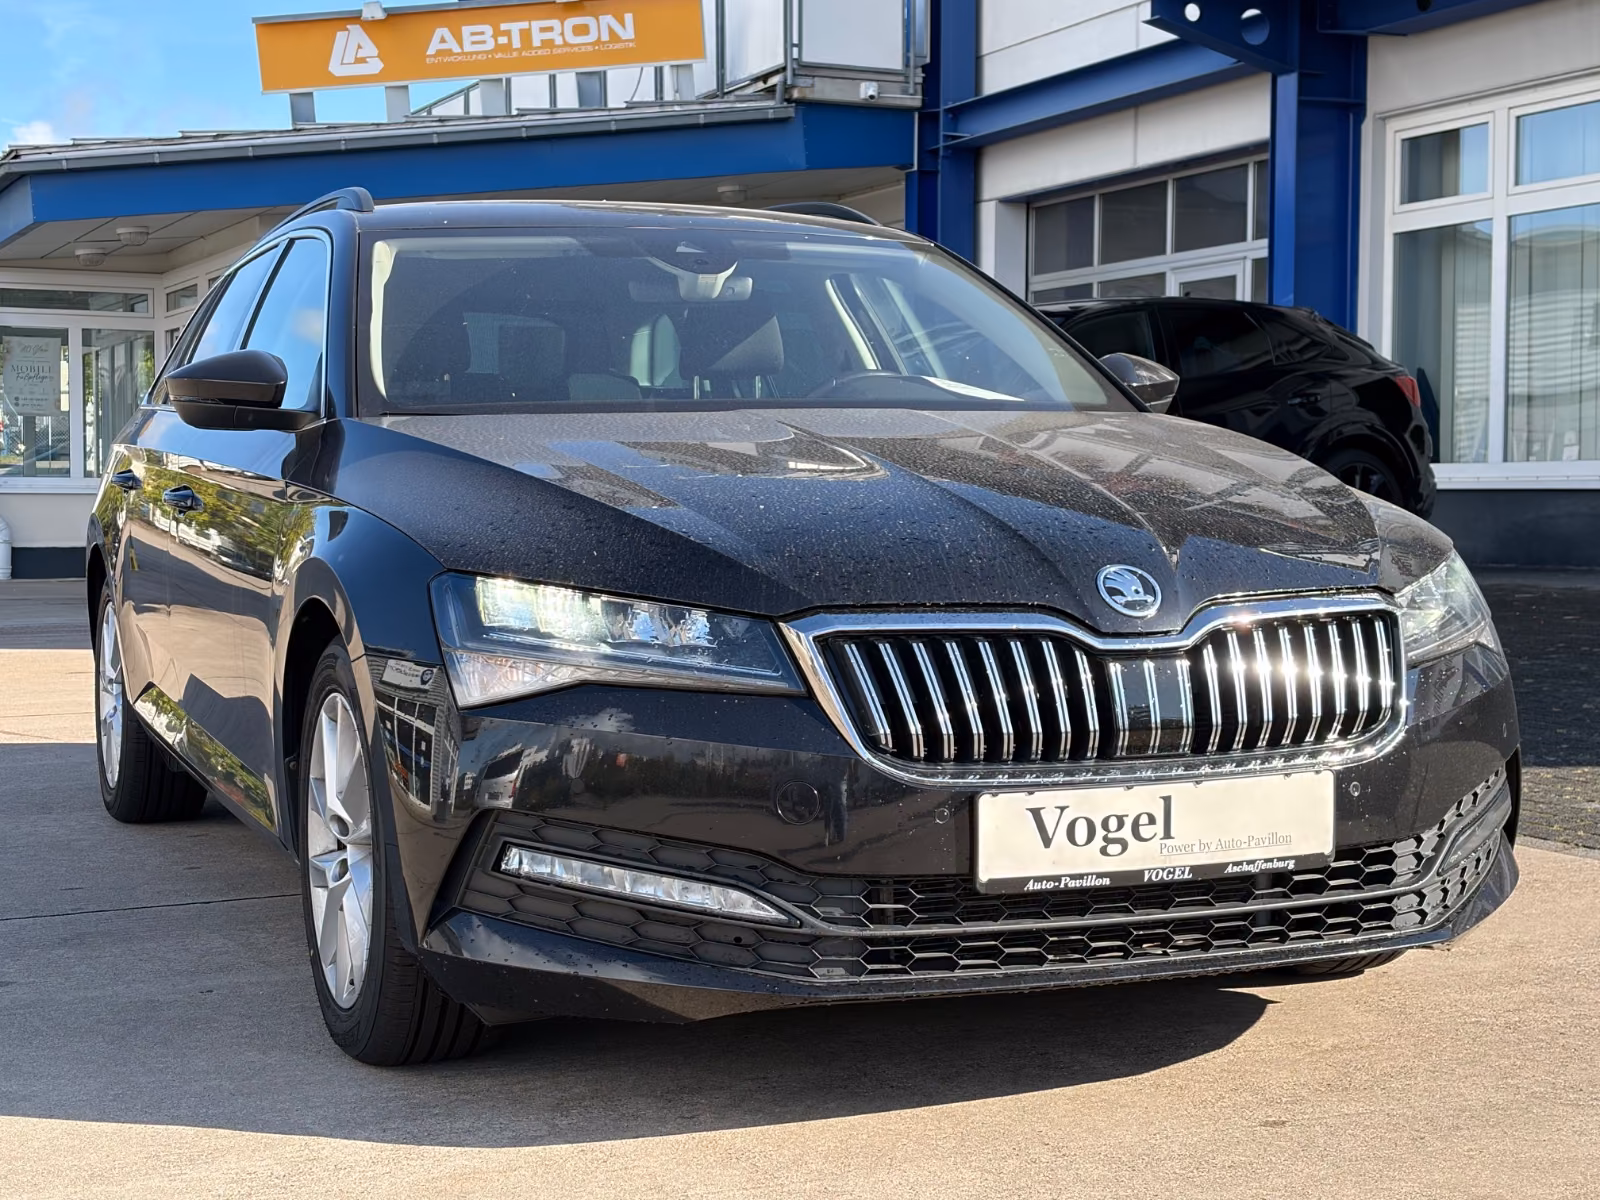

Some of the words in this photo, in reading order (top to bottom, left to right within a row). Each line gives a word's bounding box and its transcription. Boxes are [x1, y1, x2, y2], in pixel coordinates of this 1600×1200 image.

[426, 13, 635, 55] AB-TRON
[494, 50, 519, 59] VALUE
[521, 48, 551, 56] ADDED
[553, 45, 594, 54] SERVICES
[600, 41, 637, 51] LOGISTIK
[1025, 795, 1175, 857] Vogel
[1159, 841, 1196, 855] Power
[1198, 838, 1213, 854] by
[1215, 831, 1292, 850] Auto-Pavillon
[1024, 875, 1111, 891] Auto-Pavillon
[1143, 866, 1193, 882] VOGEL
[1224, 859, 1296, 874] Aschaffenburg
